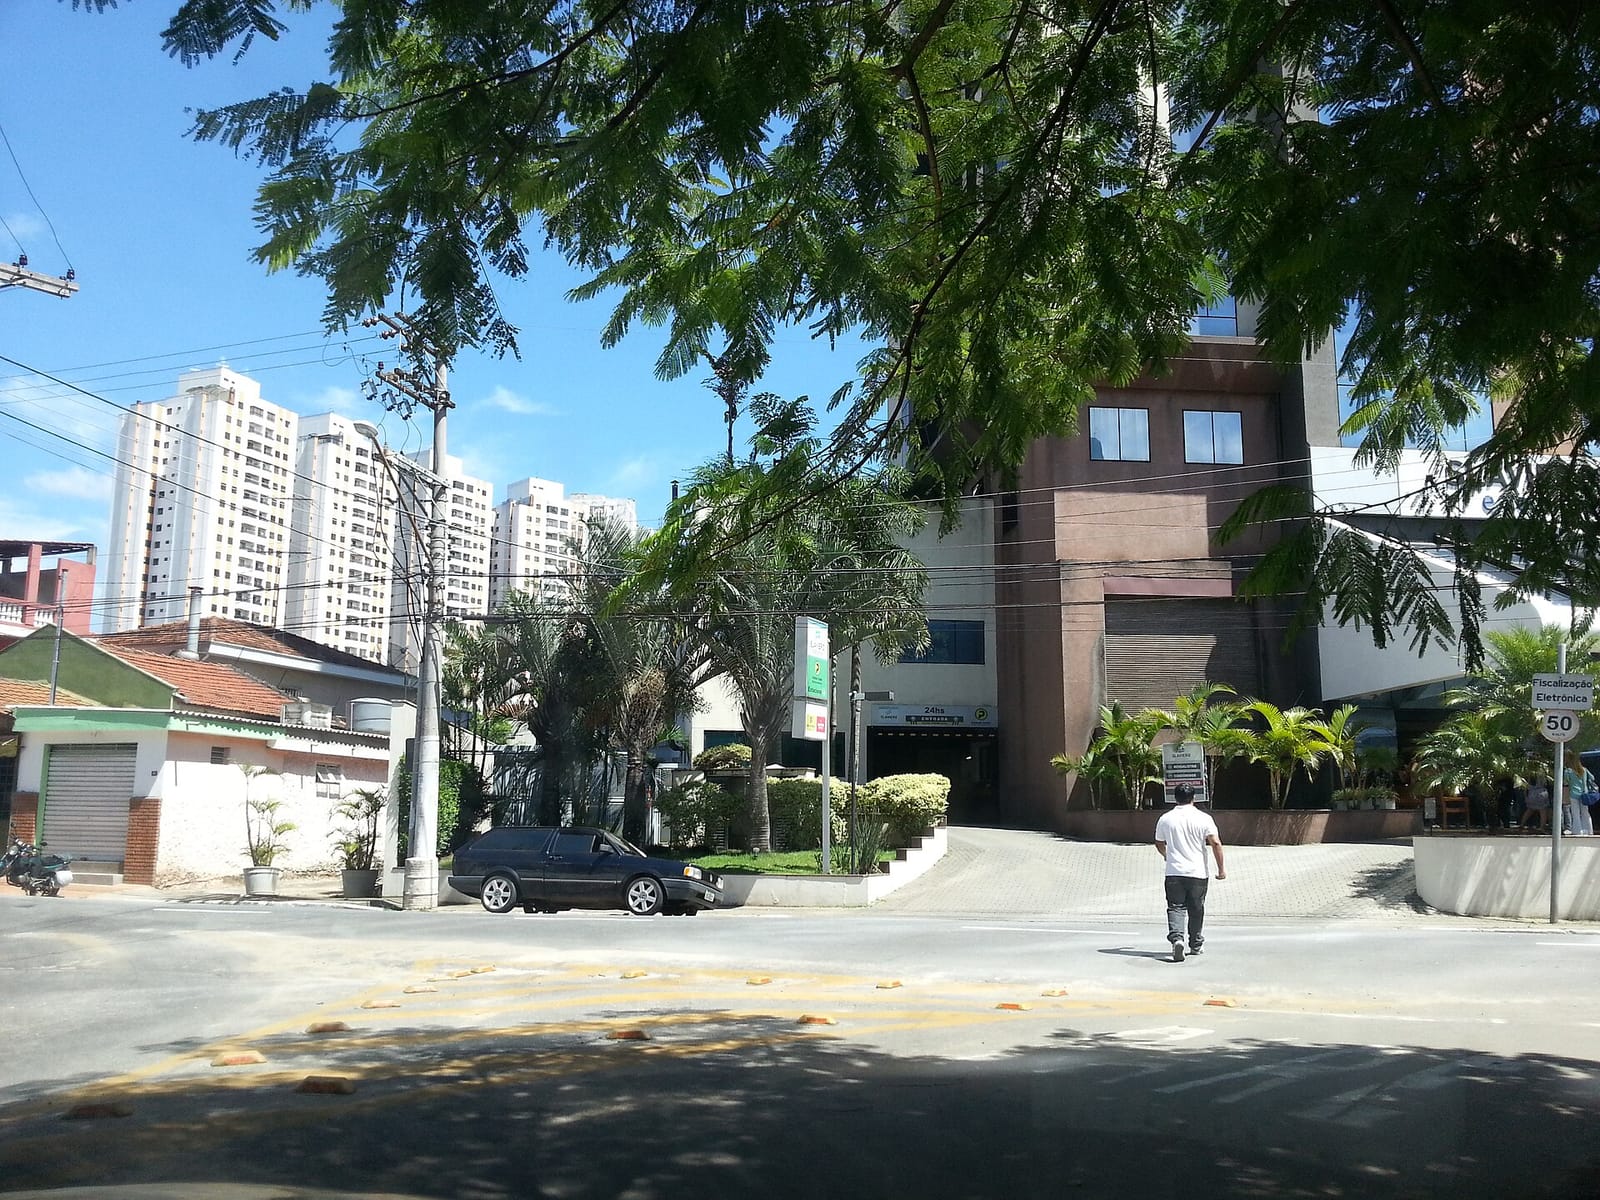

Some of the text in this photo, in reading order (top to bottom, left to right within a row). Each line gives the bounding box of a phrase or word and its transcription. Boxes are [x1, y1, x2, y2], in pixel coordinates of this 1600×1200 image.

[1532, 678, 1593, 690] Fiscalização
[1536, 692, 1588, 703] Eletrônica
[924, 706, 945, 715] 24hs
[1546, 715, 1573, 731] 50
